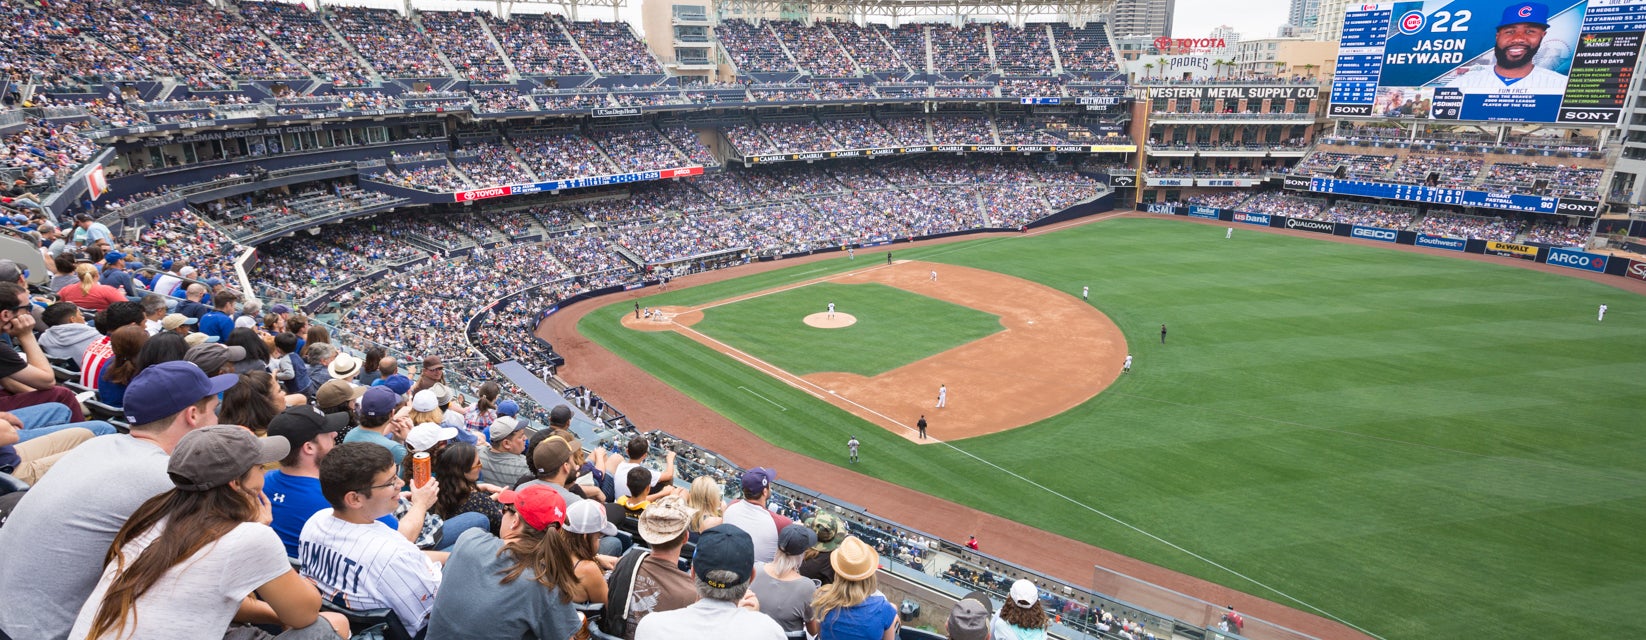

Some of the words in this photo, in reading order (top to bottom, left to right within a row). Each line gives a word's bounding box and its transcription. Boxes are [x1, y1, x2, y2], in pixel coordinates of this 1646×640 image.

[1431, 10, 1472, 32] 22
[1177, 38, 1225, 48] TOYOTA
[1412, 39, 1466, 51] JASON
[1171, 57, 1208, 70] PADRES
[1386, 52, 1463, 64] HEYWARD
[1150, 88, 1202, 98] WESTERN
[1207, 88, 1245, 98] METAL
[1248, 88, 1294, 98] SUPPLY
[1298, 88, 1317, 98] CO.
[144, 139, 173, 147] JERRY
[177, 133, 222, 144] COLEMAN
[225, 128, 283, 139] BROADCAST
[286, 125, 324, 133] CENTER
[476, 188, 504, 197] TOYOTA
[1559, 202, 1598, 211] SONY
[1287, 218, 1332, 231] QUALCOMM
[1354, 228, 1396, 240] GEICO
[1418, 236, 1456, 247] Southwest
[1549, 252, 1589, 266] ARCO
